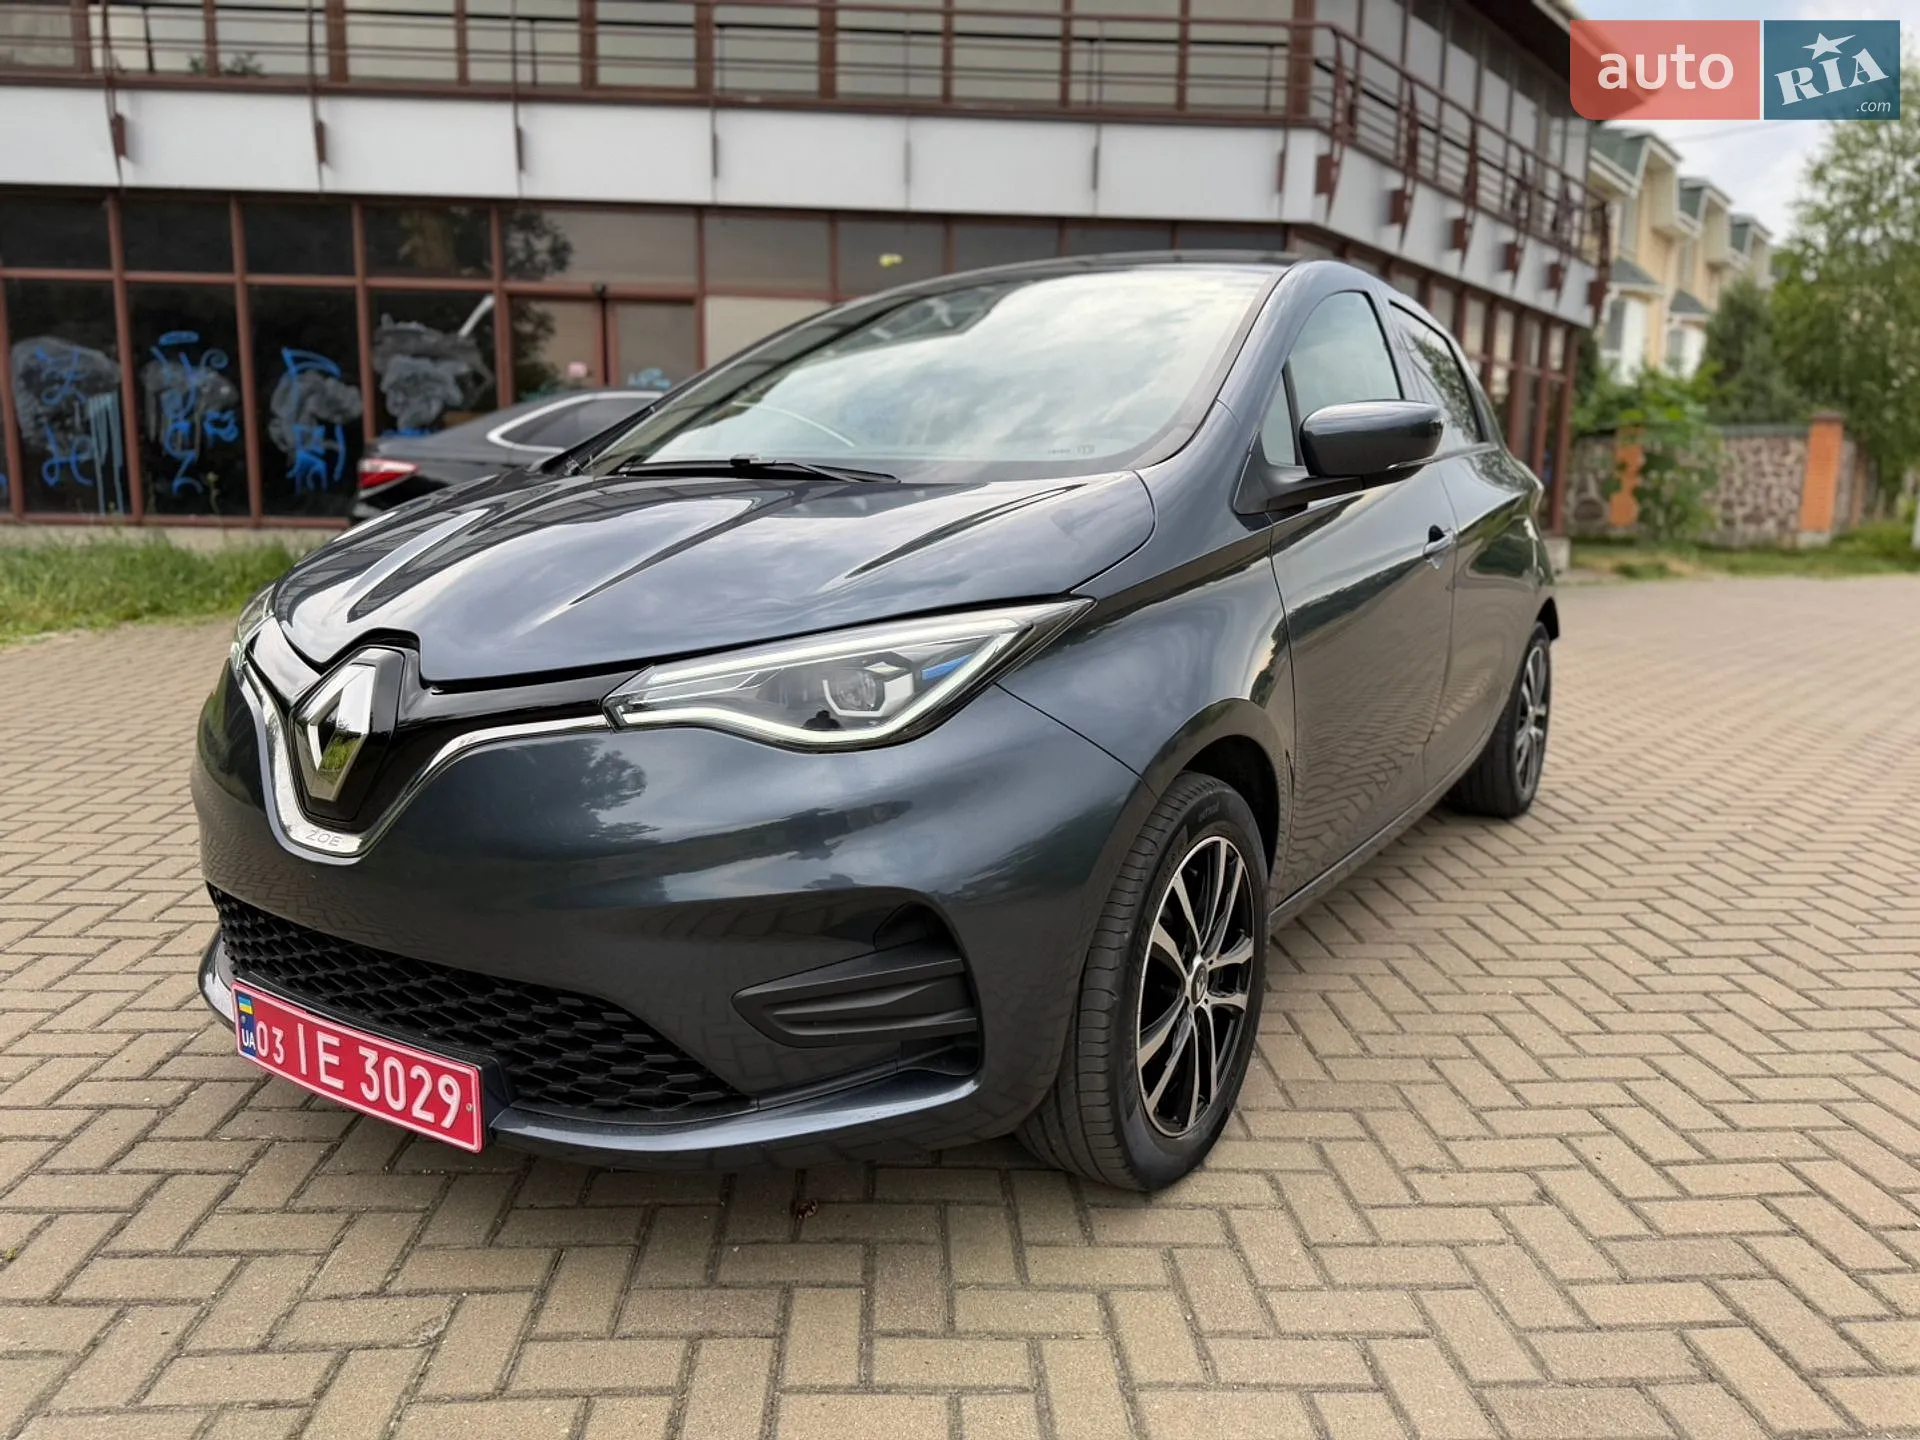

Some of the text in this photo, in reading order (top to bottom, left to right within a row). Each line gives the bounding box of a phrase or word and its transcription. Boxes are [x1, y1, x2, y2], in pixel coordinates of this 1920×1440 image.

[305, 829, 343, 847] ZOE
[241, 1028, 256, 1051] UA
[256, 1021, 461, 1129] 03 IE 3029
